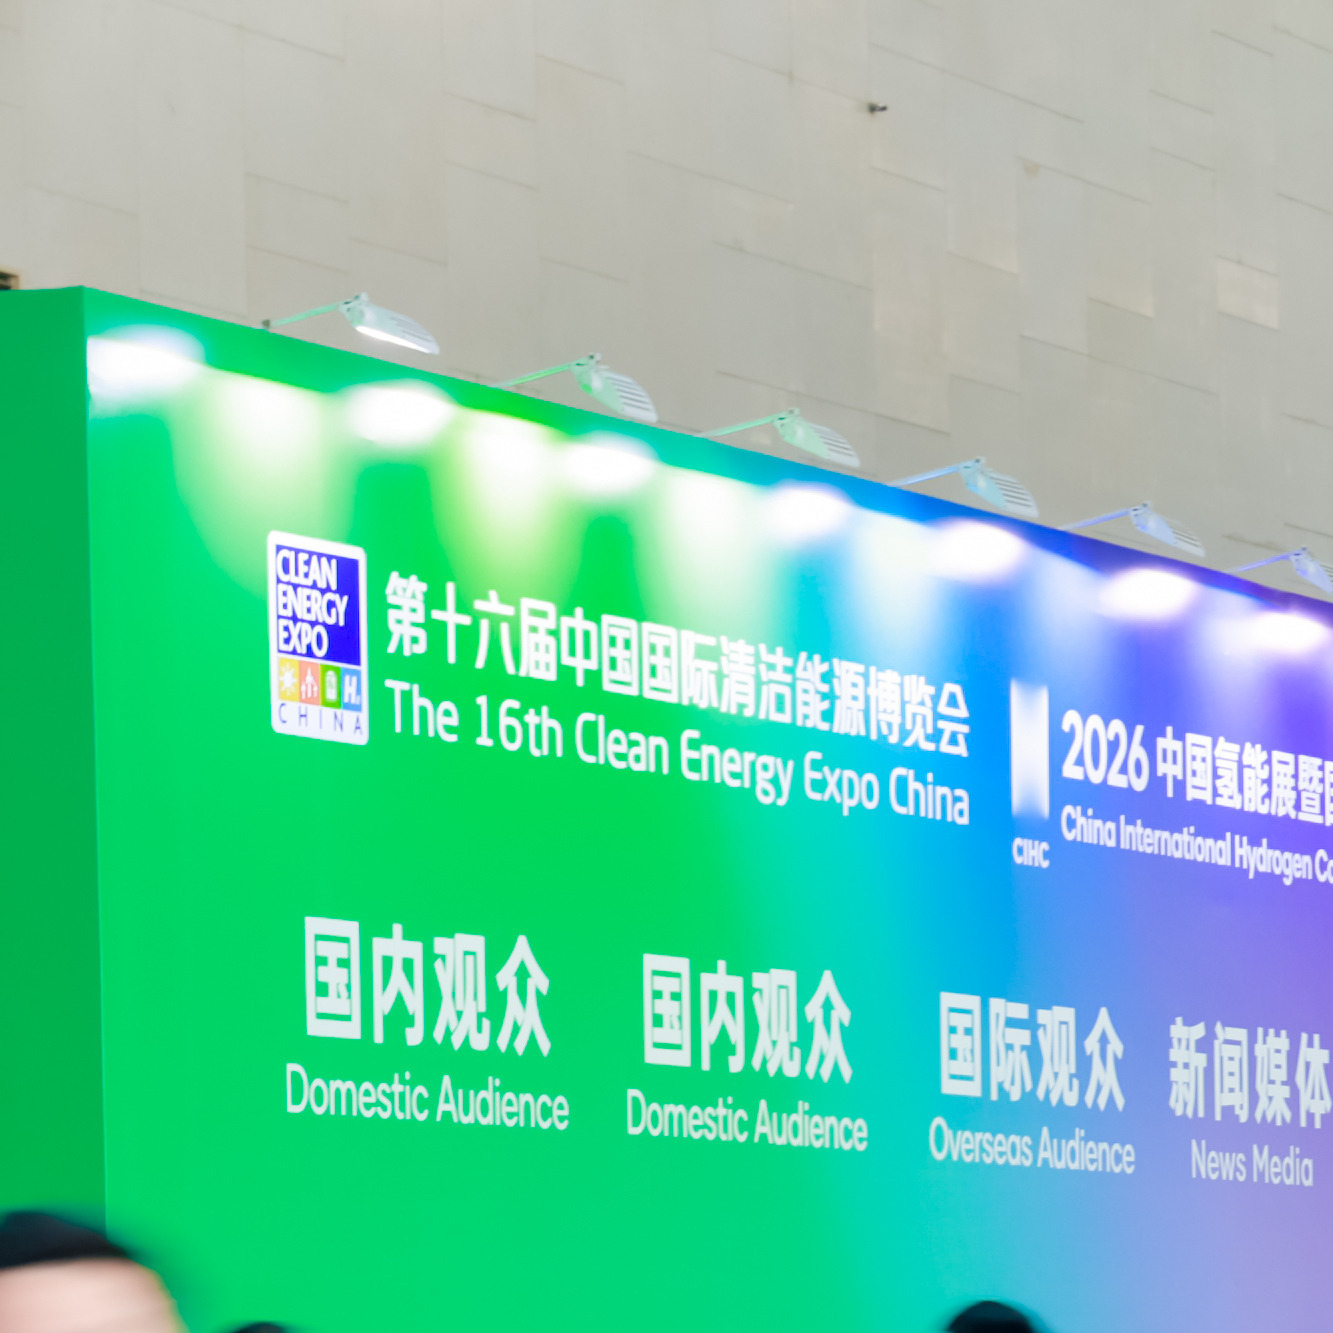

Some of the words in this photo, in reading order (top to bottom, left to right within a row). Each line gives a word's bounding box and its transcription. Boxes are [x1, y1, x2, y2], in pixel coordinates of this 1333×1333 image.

[276, 547, 336, 592] CLEAN
[277, 582, 348, 629] ENERGY
[277, 614, 328, 658] EXPO
[385, 571, 970, 757] 第十六届中国国际清洁能源博览会
[277, 702, 364, 737] CHINA
[385, 679, 458, 743] The
[475, 694, 563, 758] 16th
[575, 714, 668, 776] Clean
[681, 729, 793, 806] Energy
[804, 751, 879, 816] Expo
[889, 766, 969, 825] China
[1061, 709, 1150, 793] 2026
[1012, 836, 1050, 869] CIHC
[1061, 805, 1116, 849] China
[1120, 815, 1232, 867] International
[1234, 835, 1312, 886] Hydrogen
[304, 916, 552, 1058] 国内观众
[642, 953, 853, 1084] 国内观众
[939, 990, 1125, 1112] 国际观众
[1169, 1017, 1332, 1129] 新闻媒体
[286, 1063, 429, 1122] Domestic
[436, 1075, 569, 1131] Audience
[627, 1088, 749, 1142] Domestic
[754, 1099, 868, 1151] Audience
[928, 1116, 1033, 1167] Overseas
[1037, 1127, 1136, 1175] Audience
[1191, 1139, 1246, 1181] News
[1252, 1144, 1314, 1186] Media
